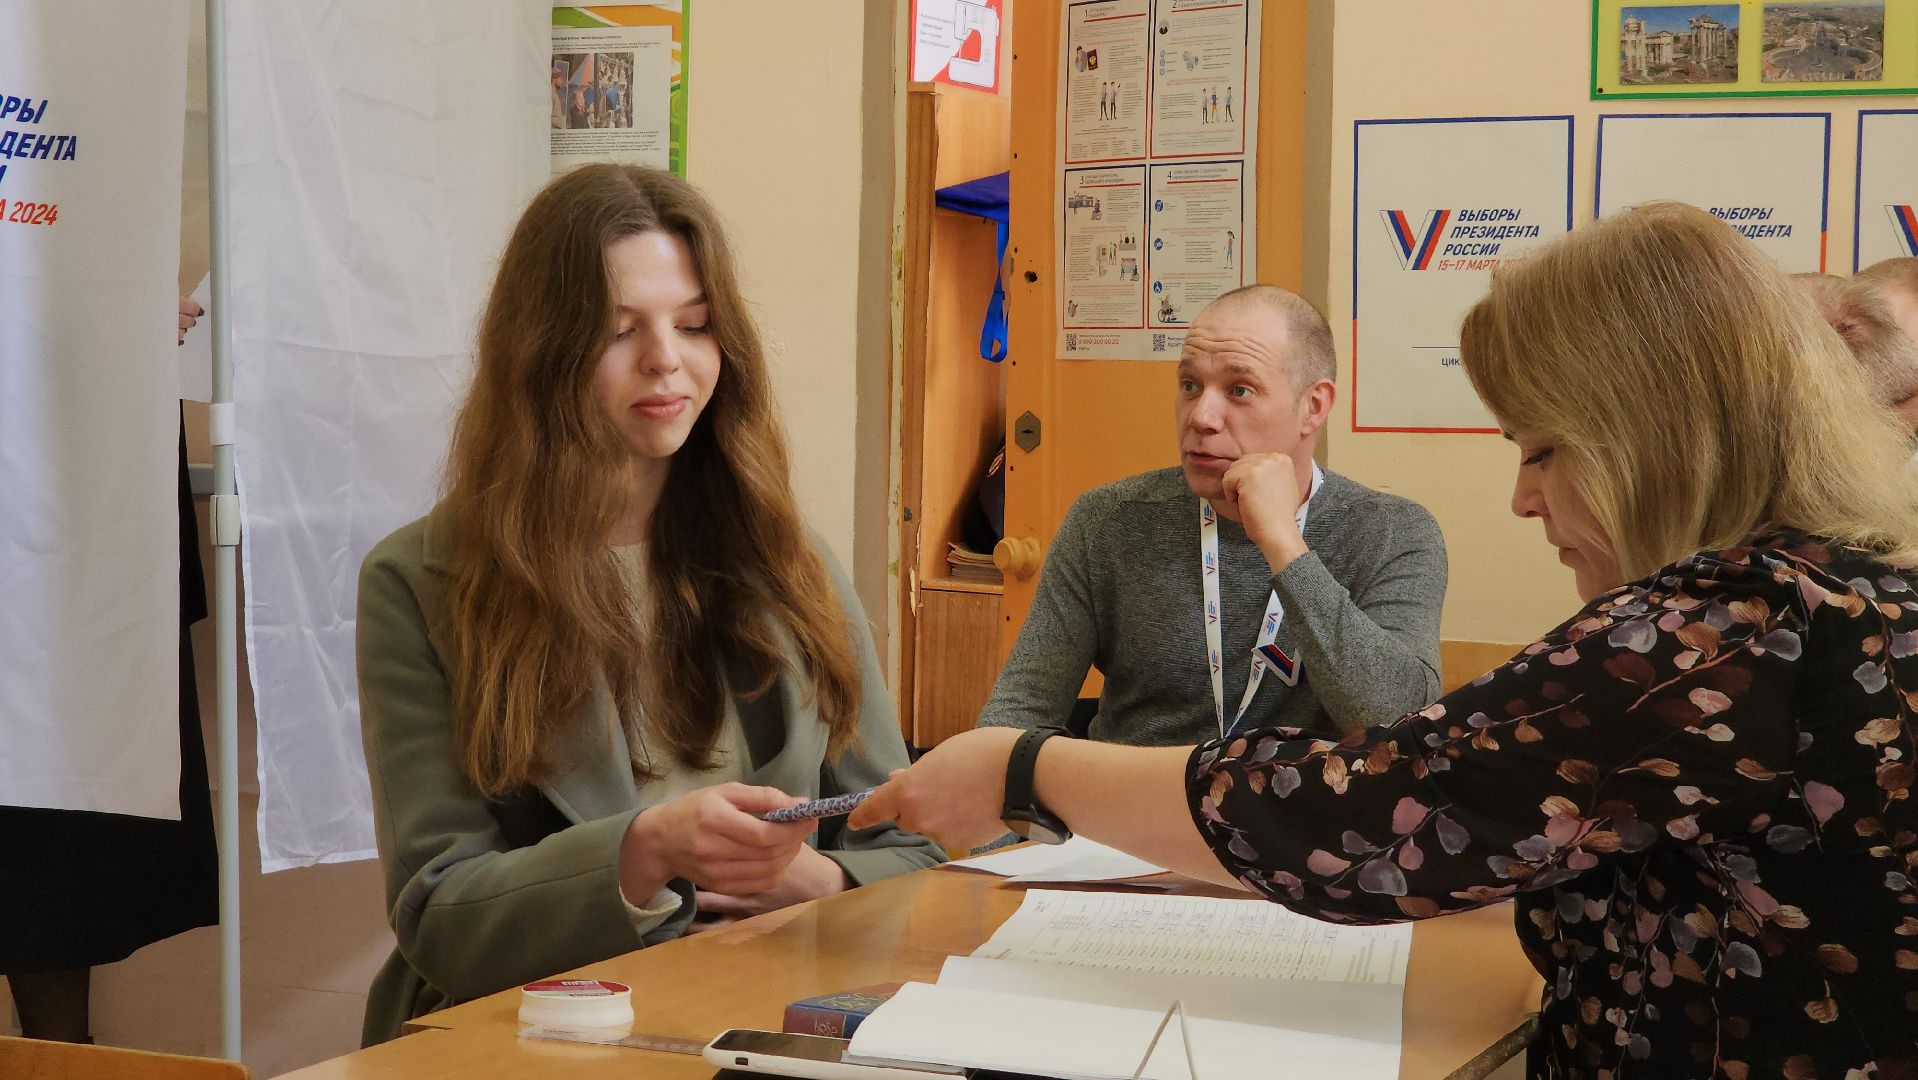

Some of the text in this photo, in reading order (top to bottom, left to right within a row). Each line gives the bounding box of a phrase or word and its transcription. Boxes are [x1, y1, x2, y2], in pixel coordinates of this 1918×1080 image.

[1080, 175, 1085, 185] 3
[1167, 170, 1173, 180] 4
[8, 201, 58, 225] 2024
[1458, 208, 1522, 222] ВЫБОРЫ
[1709, 207, 1774, 220] ВЫБОРЫ
[1450, 225, 1540, 240] ПРЕЗИДЕНТА
[1443, 243, 1501, 256] РОССИИ
[1441, 357, 1460, 368] ЦИК
